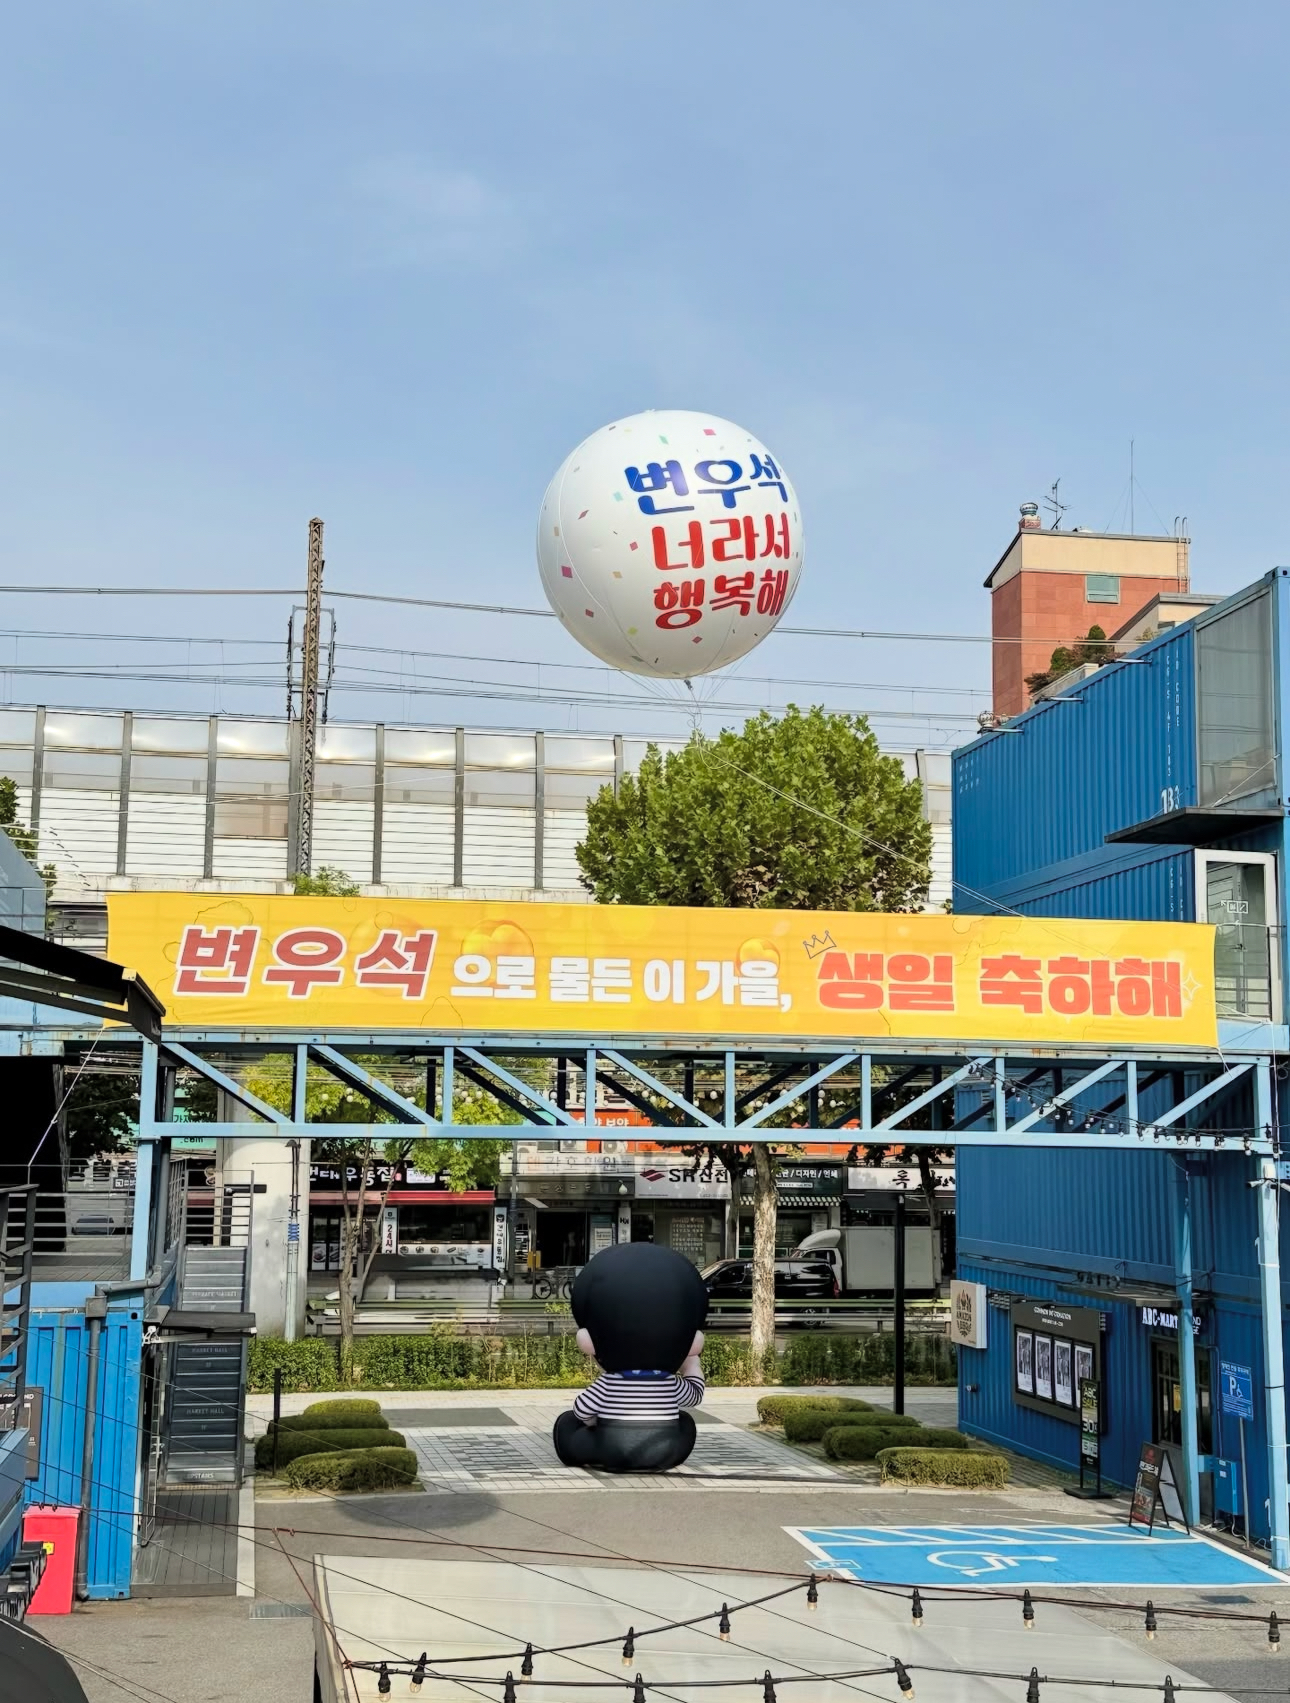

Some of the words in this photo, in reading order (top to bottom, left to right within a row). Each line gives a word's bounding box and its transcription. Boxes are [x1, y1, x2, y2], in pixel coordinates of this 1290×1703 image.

[625, 454, 788, 515] 변우석
[652, 512, 790, 570] 너라서
[654, 569, 789, 629] 행복해
[173, 924, 437, 1000] 변우석
[450, 954, 536, 999] 으로
[549, 957, 632, 1002] 물든
[643, 958, 686, 1003] 이
[695, 958, 792, 1013] 가을,
[817, 951, 956, 1013] 생일
[979, 954, 1183, 1018] 축하해
[1142, 1306, 1178, 1329] ABC-MART
[1229, 1375, 1237, 1396] P
